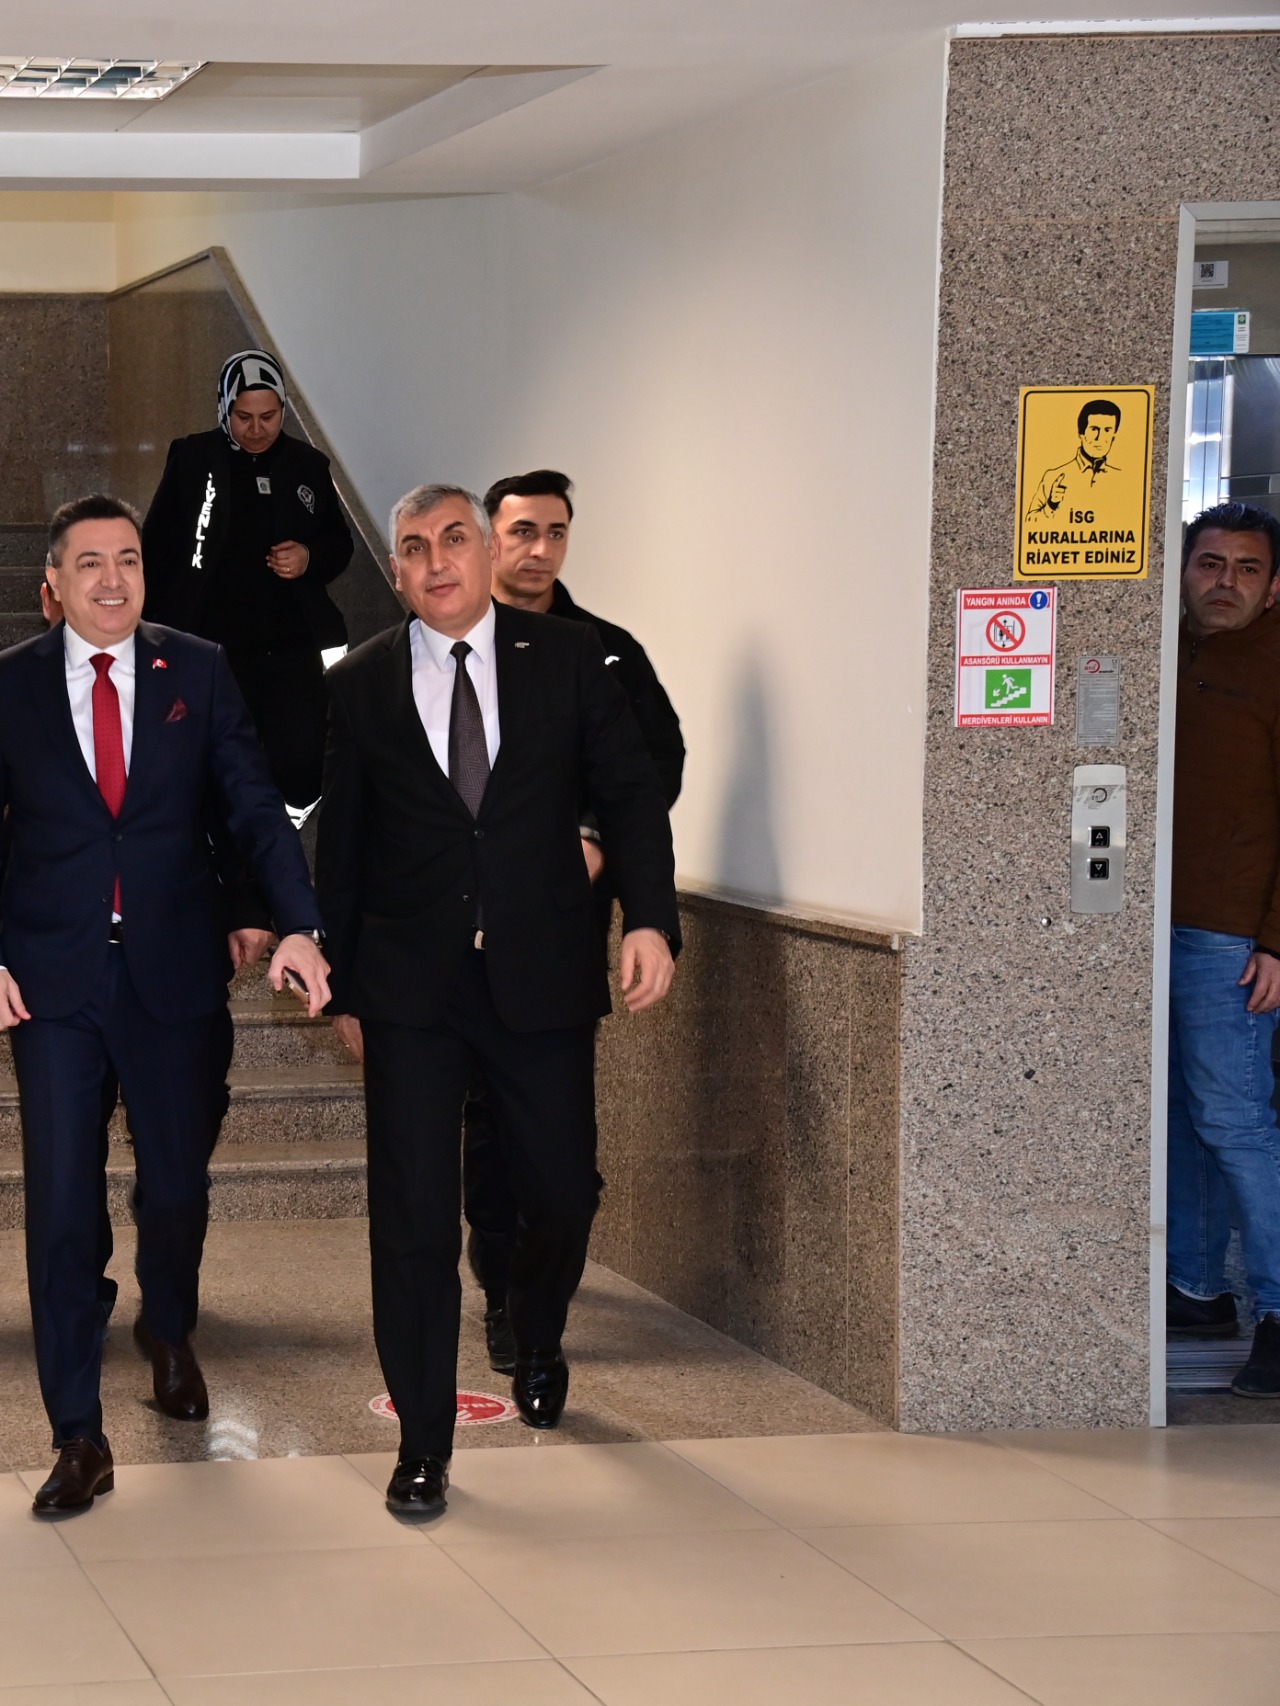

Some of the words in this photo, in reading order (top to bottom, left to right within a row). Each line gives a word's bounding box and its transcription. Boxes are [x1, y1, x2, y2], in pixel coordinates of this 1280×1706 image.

[1069, 508, 1095, 524] İSG
[1027, 530, 1135, 544] KURALLARINA
[1026, 548, 1080, 565] RİAYET
[1084, 547, 1136, 564] EDİNİZ
[965, 597, 995, 607] YANGIN
[996, 597, 1026, 607] ANINDA
[963, 655, 1001, 666] ASANSÖRÜ
[1001, 656, 1049, 665] KULLANMAYIN
[962, 716, 1011, 725] MERDİVENLERİ
[1012, 716, 1048, 725] KULLANIN
